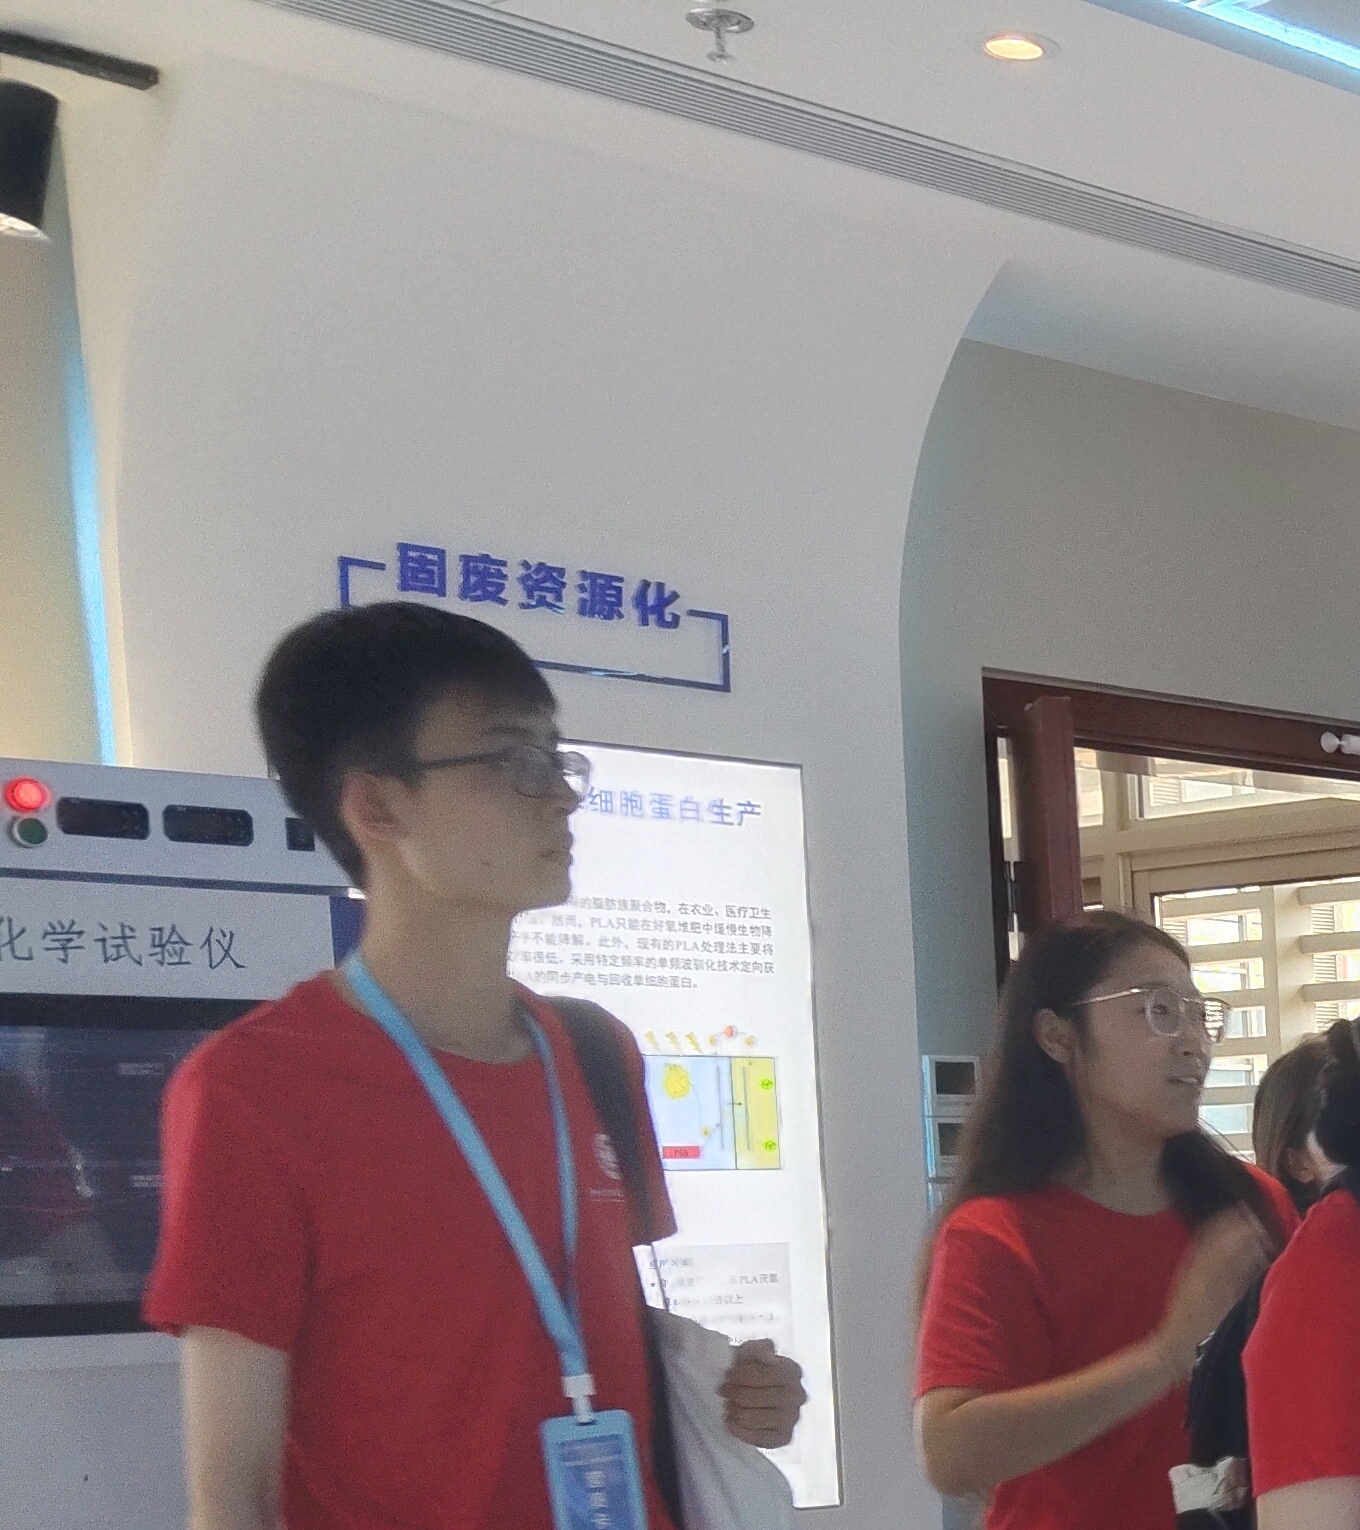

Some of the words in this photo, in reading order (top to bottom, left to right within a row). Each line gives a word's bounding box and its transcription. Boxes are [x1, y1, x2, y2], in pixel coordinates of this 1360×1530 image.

[396, 542, 681, 630] 固废资源化
[586, 786, 761, 826] 细胞蛋白生产
[0, 916, 246, 970] 化学试验仪
